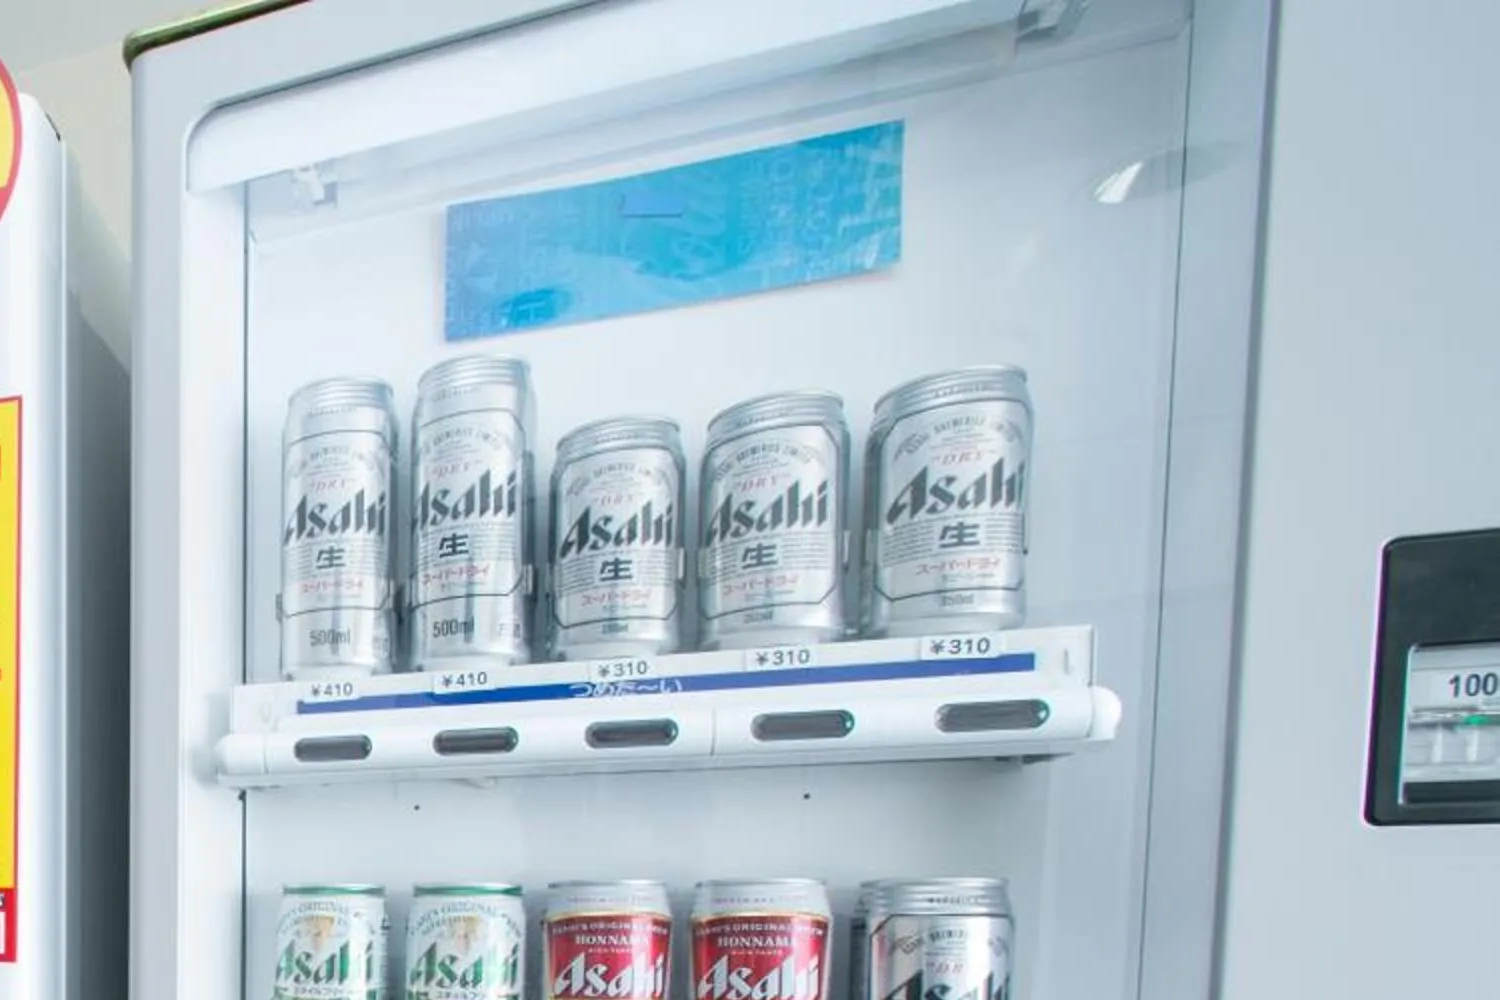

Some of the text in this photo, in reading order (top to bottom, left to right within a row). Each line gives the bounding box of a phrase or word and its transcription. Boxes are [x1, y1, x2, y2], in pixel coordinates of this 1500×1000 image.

[411, 469, 518, 533] Asahi
[886, 457, 1026, 526] Asahi
[284, 489, 387, 546] Asahi
[705, 479, 829, 547] Asahi
[560, 501, 673, 559] Asahi
[938, 522, 981, 548] 生
[316, 546, 346, 569] 生
[439, 533, 469, 558] 生
[742, 543, 778, 569] 生
[599, 557, 634, 582] 生
[432, 616, 475, 638] 500ml
[755, 649, 811, 667] ¥310
[930, 637, 990, 655] ¥310
[441, 672, 488, 688] ¥410
[598, 661, 648, 679] ¥310
[310, 682, 353, 697] ¥410
[552, 951, 664, 998] Asahi
[698, 954, 820, 1000] Asahi
